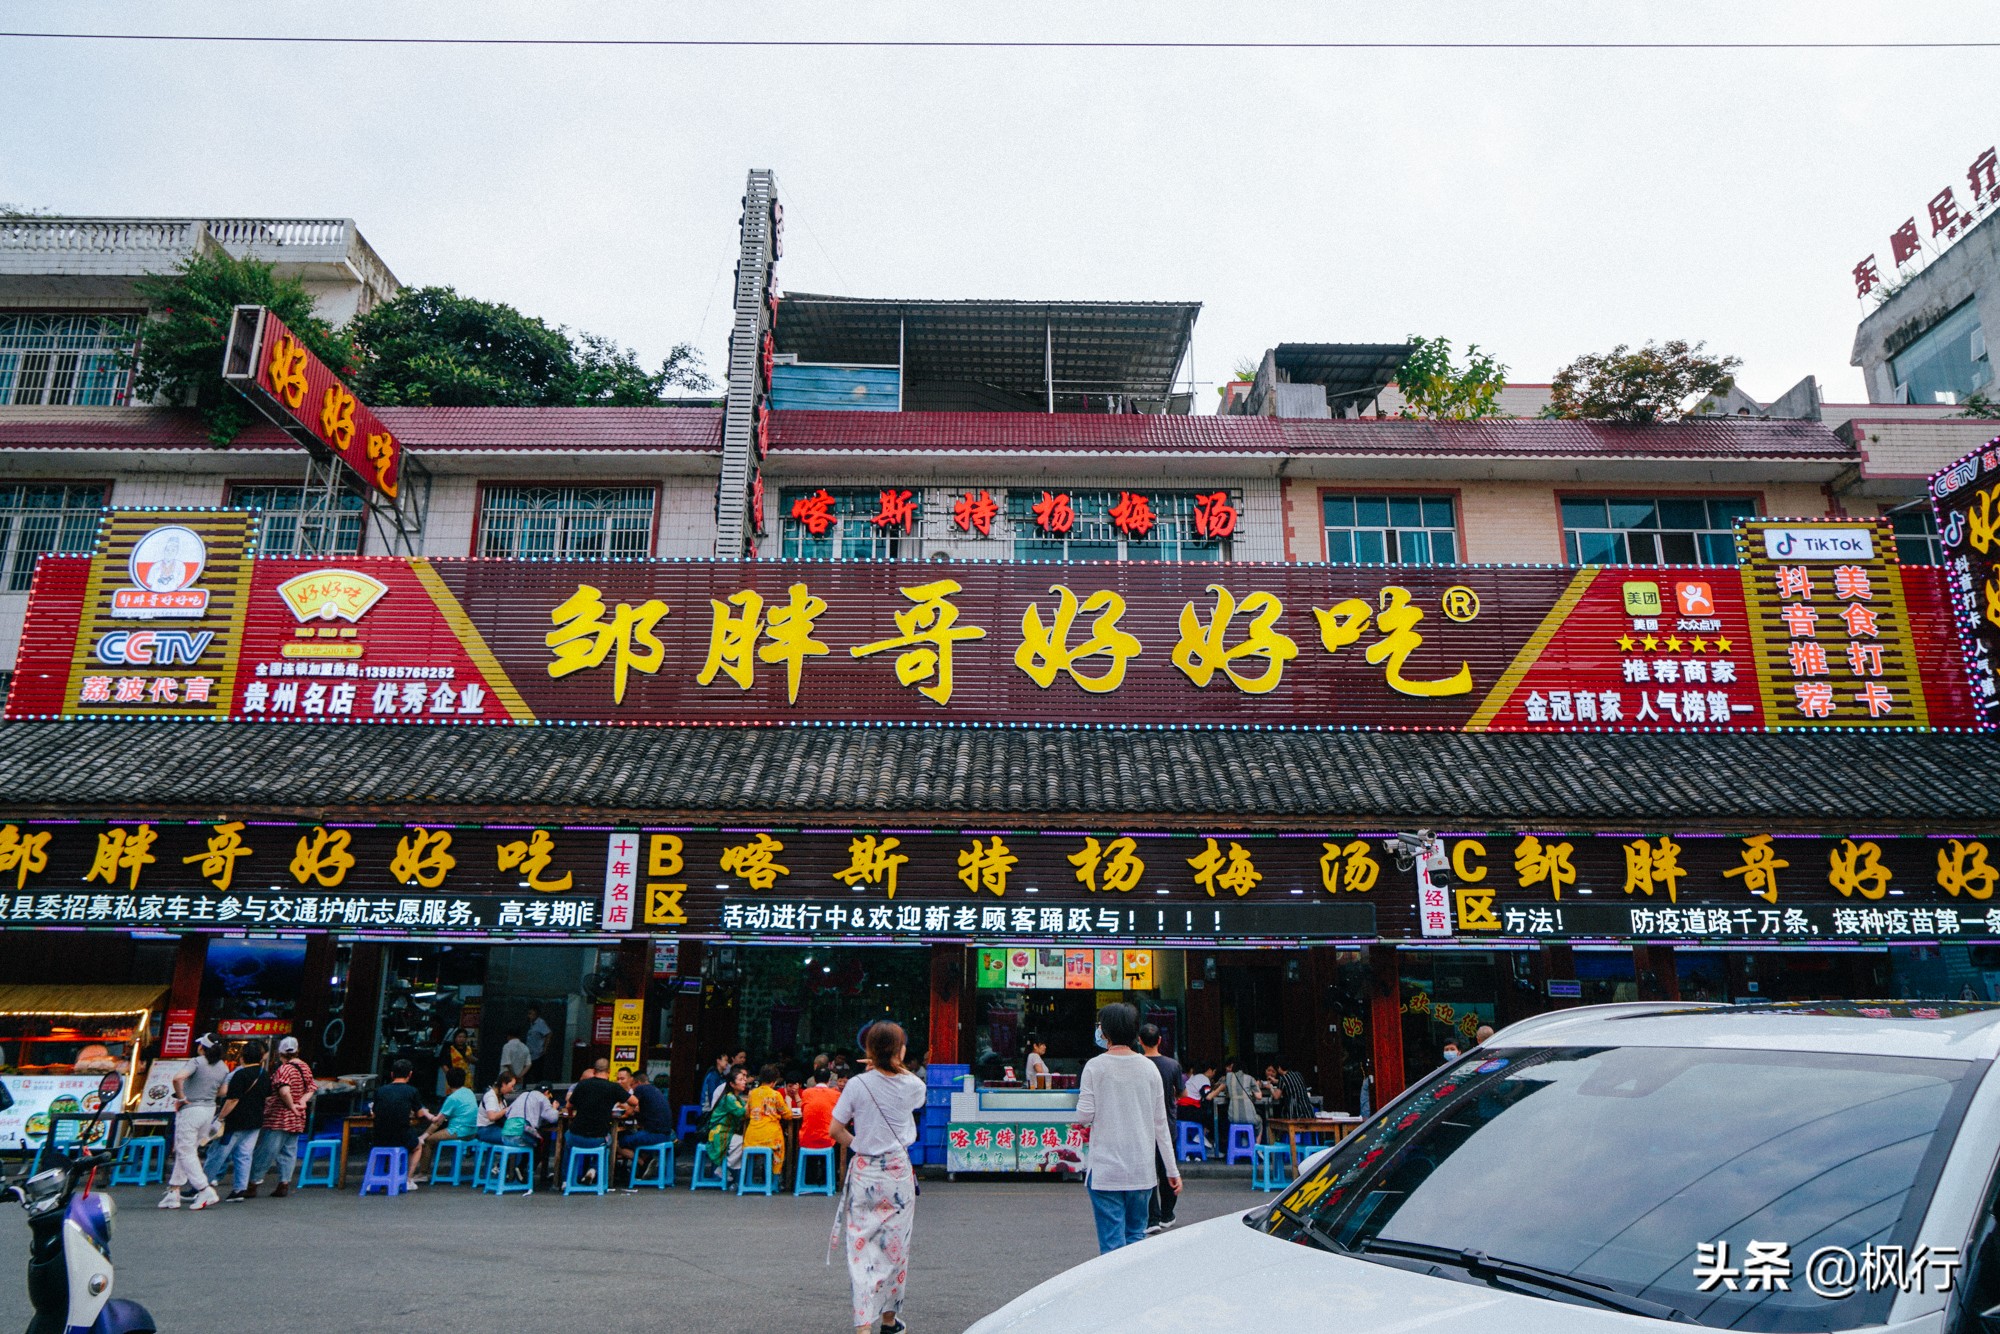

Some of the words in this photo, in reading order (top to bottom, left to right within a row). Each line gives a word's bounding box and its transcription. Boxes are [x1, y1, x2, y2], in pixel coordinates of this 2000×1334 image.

[268, 333, 399, 498] 好好吃
[1935, 456, 1979, 497] CCTV
[791, 489, 1238, 537] 喀斯特杨梅汤
[1803, 537, 1863, 553] TikTok
[1627, 592, 1658, 605] 美团
[1955, 555, 1981, 629] 抖音打卡
[545, 580, 1472, 707] 邹胖哥好好吃
[1633, 619, 1659, 631] 美团
[1677, 619, 1721, 631] 大众点评
[1775, 566, 1836, 718] 抖音推荐
[1834, 565, 1893, 718] 美食打卡
[97, 631, 214, 664] CCTV
[82, 677, 214, 703] 荔波代言
[1622, 659, 1737, 684] 推荐商家
[243, 681, 357, 714] 贵州名店
[372, 682, 486, 715] 优秀企业
[1525, 691, 1624, 723] 金冠商家
[1635, 692, 1754, 723] 人气榜第一
[608, 841, 632, 923] 十年名店
[720, 834, 1380, 899] 喀斯特杨梅汤
[1514, 834, 2000, 903] 邹胖哥好好
[1400, 992, 1479, 1038] 欢迎您
[950, 1127, 1083, 1148] 喀斯特杨梅汤
